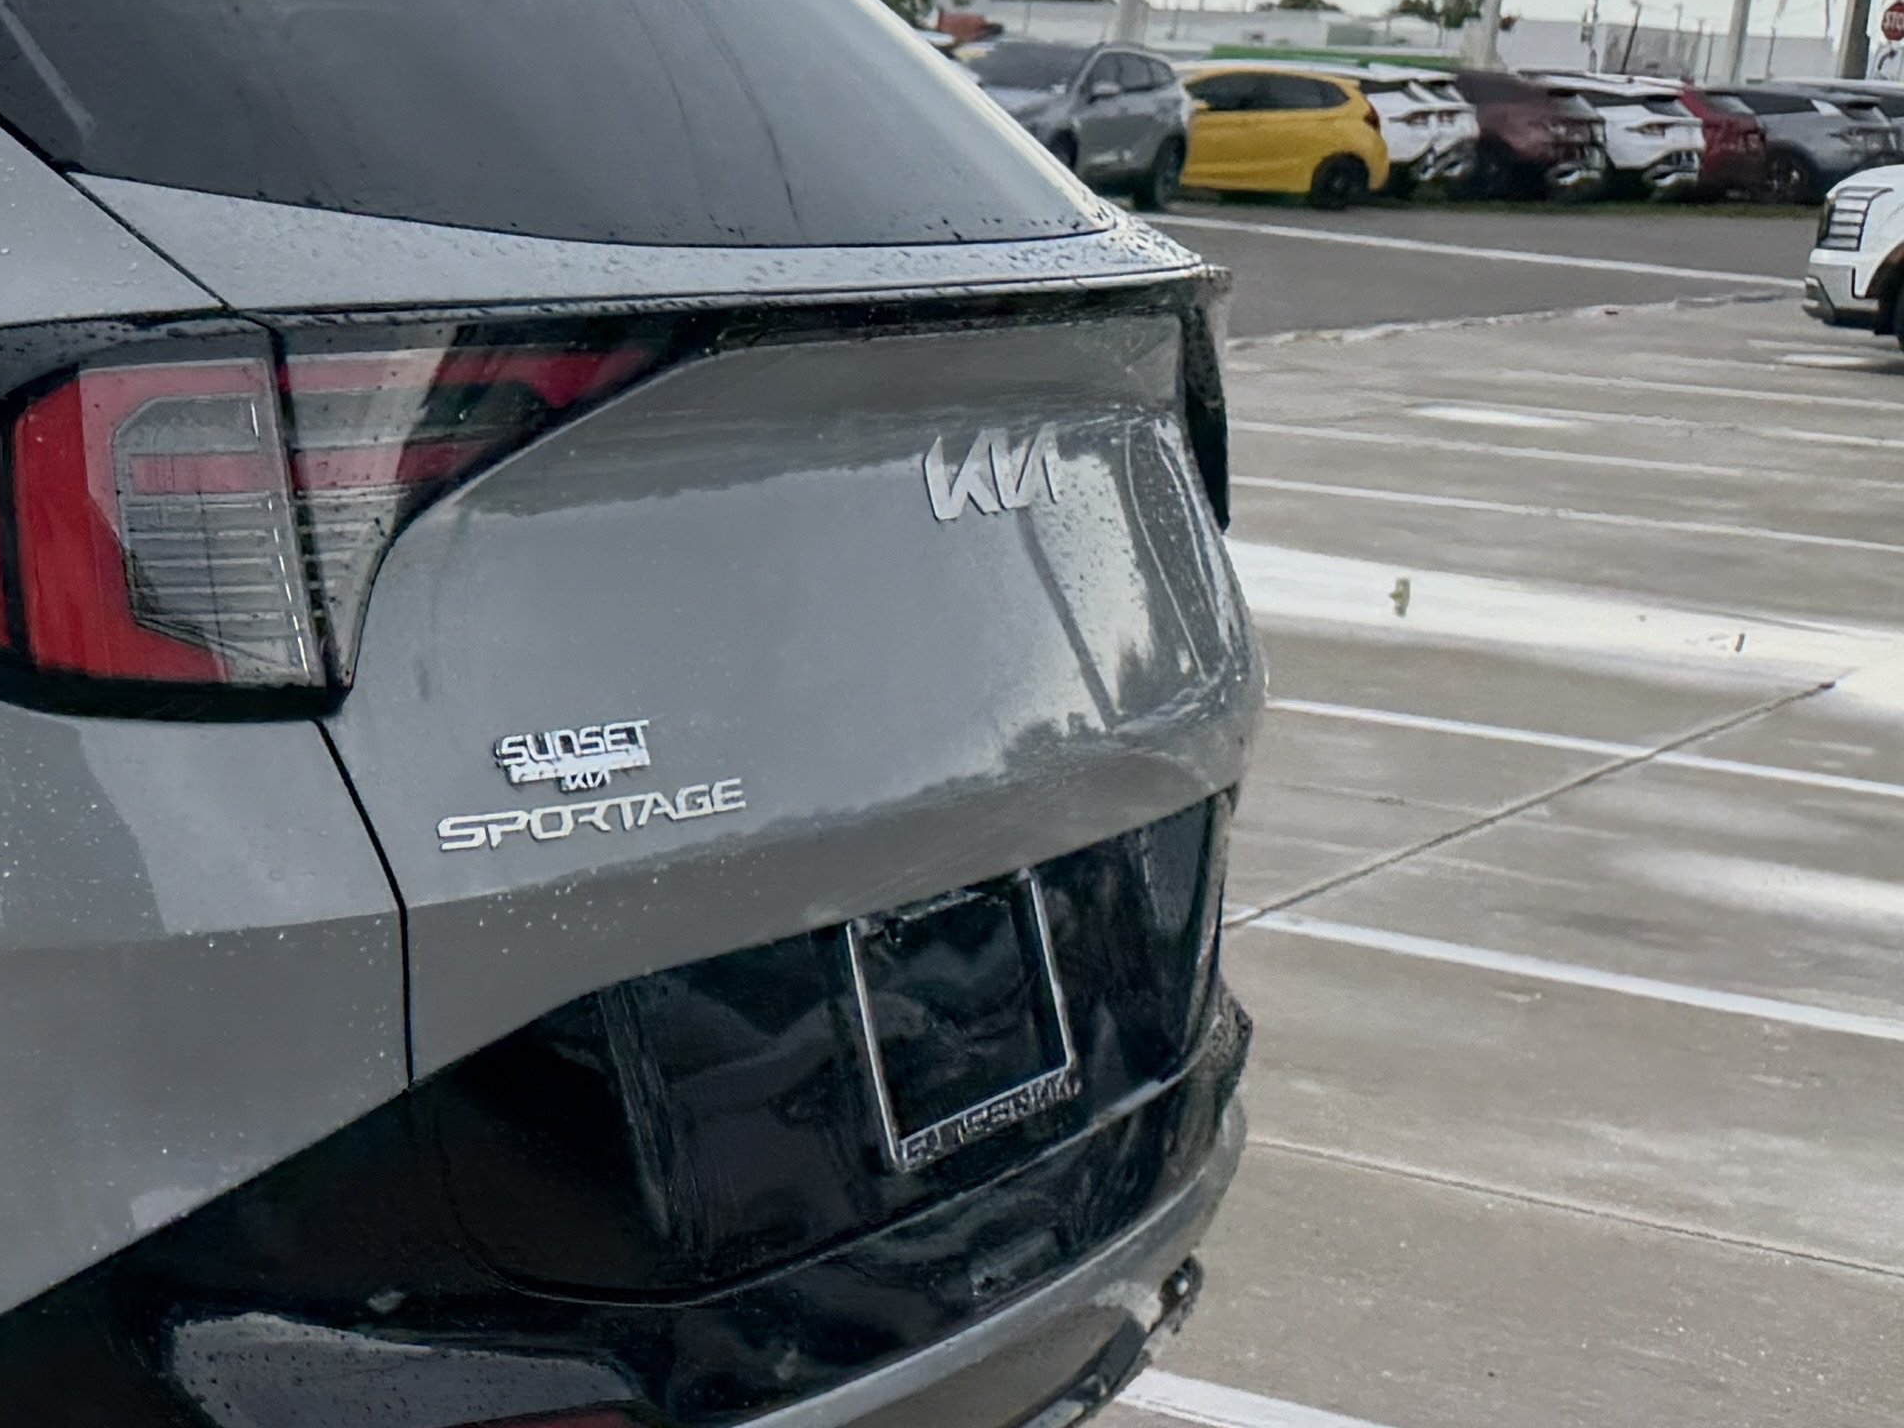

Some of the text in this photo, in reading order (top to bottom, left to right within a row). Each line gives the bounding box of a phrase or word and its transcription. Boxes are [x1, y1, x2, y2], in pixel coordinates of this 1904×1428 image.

[923, 422, 1059, 522] KIA
[495, 719, 650, 766] SUNSET
[438, 778, 747, 851] SPORTAGE
